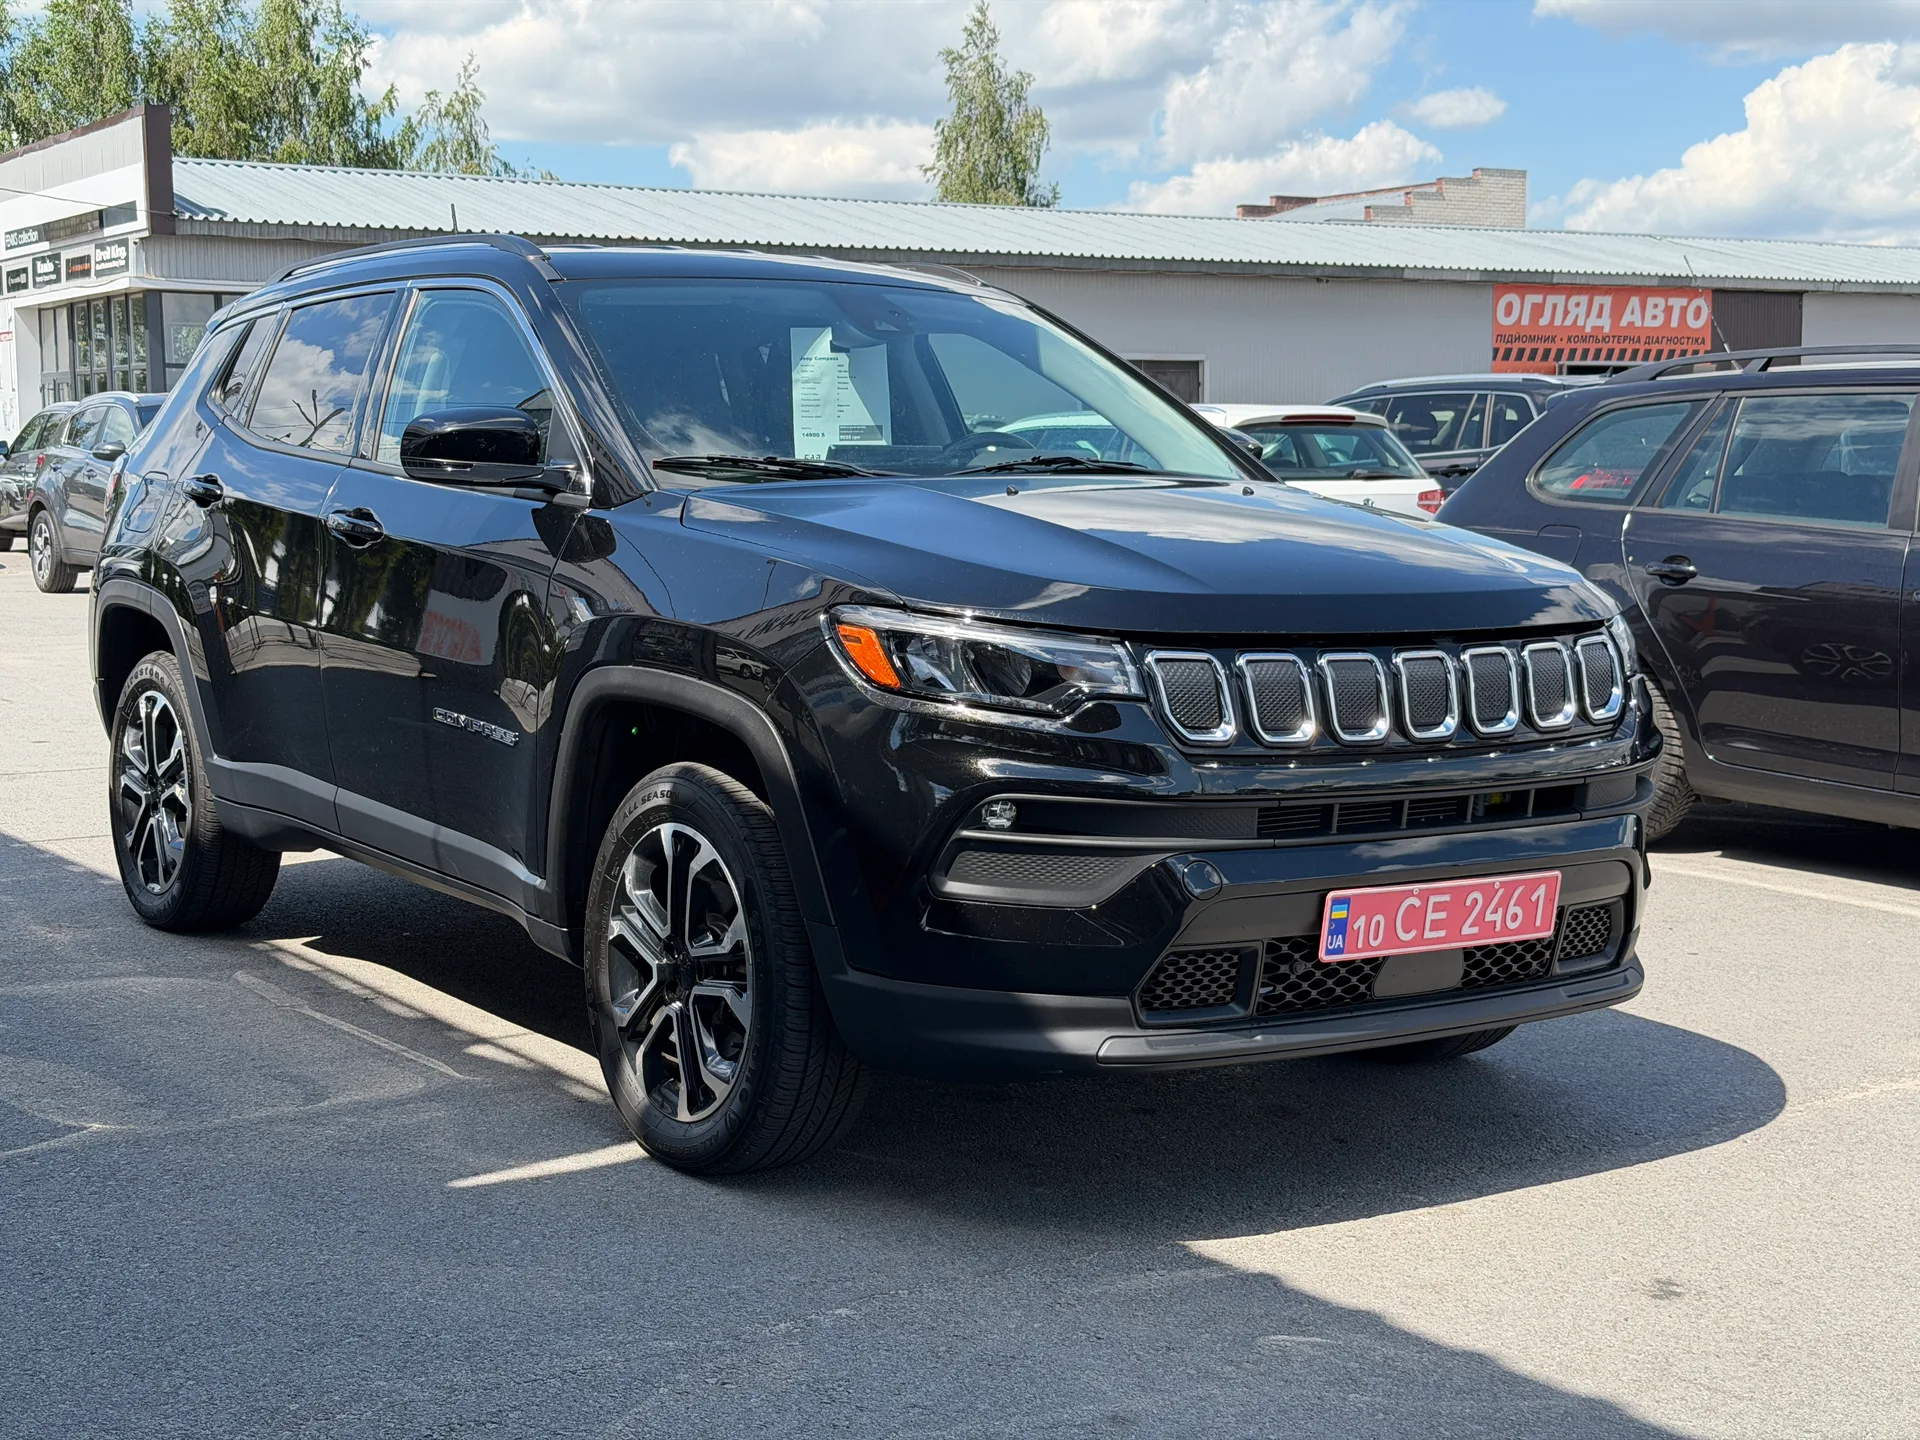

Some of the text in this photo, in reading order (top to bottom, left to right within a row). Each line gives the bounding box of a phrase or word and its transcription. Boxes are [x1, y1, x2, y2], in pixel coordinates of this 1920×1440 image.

[1496, 293, 1711, 333] ОГЛЯД АВТО
[1495, 333, 1707, 346] ПІДЙОМНИК КОМПЬЮТЕРНА ДІАГНОСТІКА
[622, 801, 639, 822] ALL
[641, 790, 680, 805] SEASON
[1352, 883, 1547, 949] 10 CE 2461
[1327, 935, 1344, 950] UA
